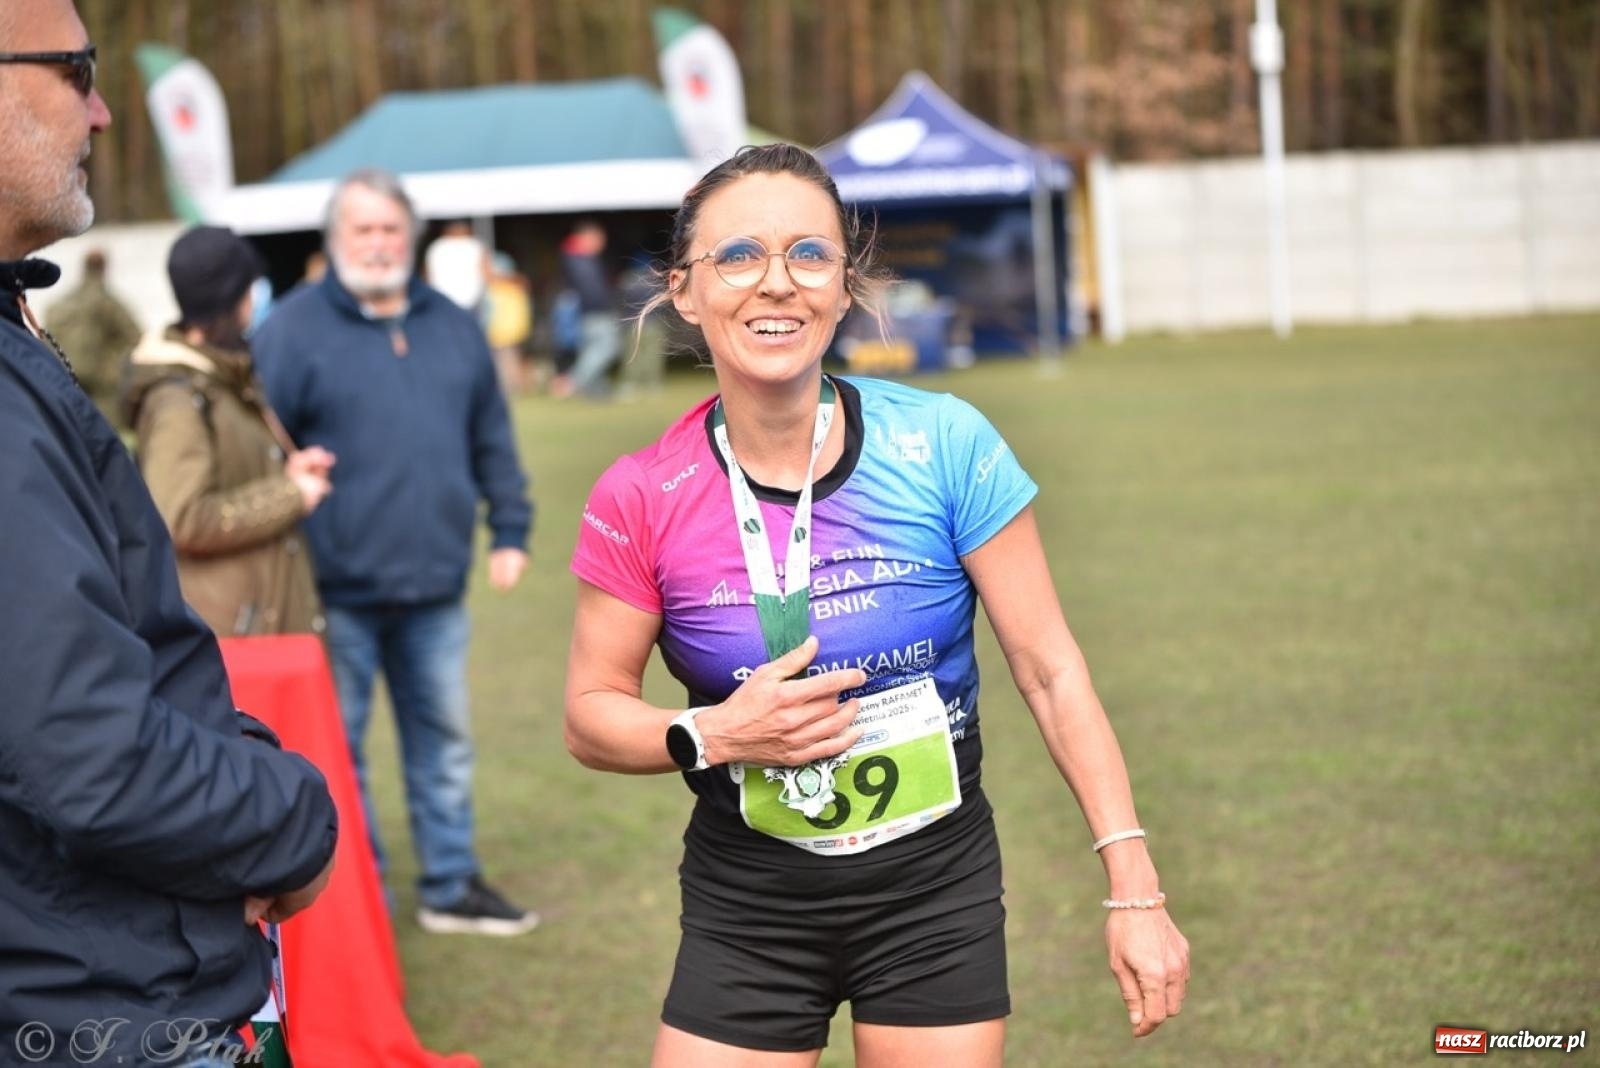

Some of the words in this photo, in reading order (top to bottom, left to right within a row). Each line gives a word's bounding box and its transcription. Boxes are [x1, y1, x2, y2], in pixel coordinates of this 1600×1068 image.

[811, 554, 826, 569] &
[810, 567, 866, 598] SIA
[809, 589, 881, 621] BNIK
[856, 637, 938, 674] KAMEL
[881, 687, 923, 706] RAFAMET
[888, 703, 910, 718] 2025
